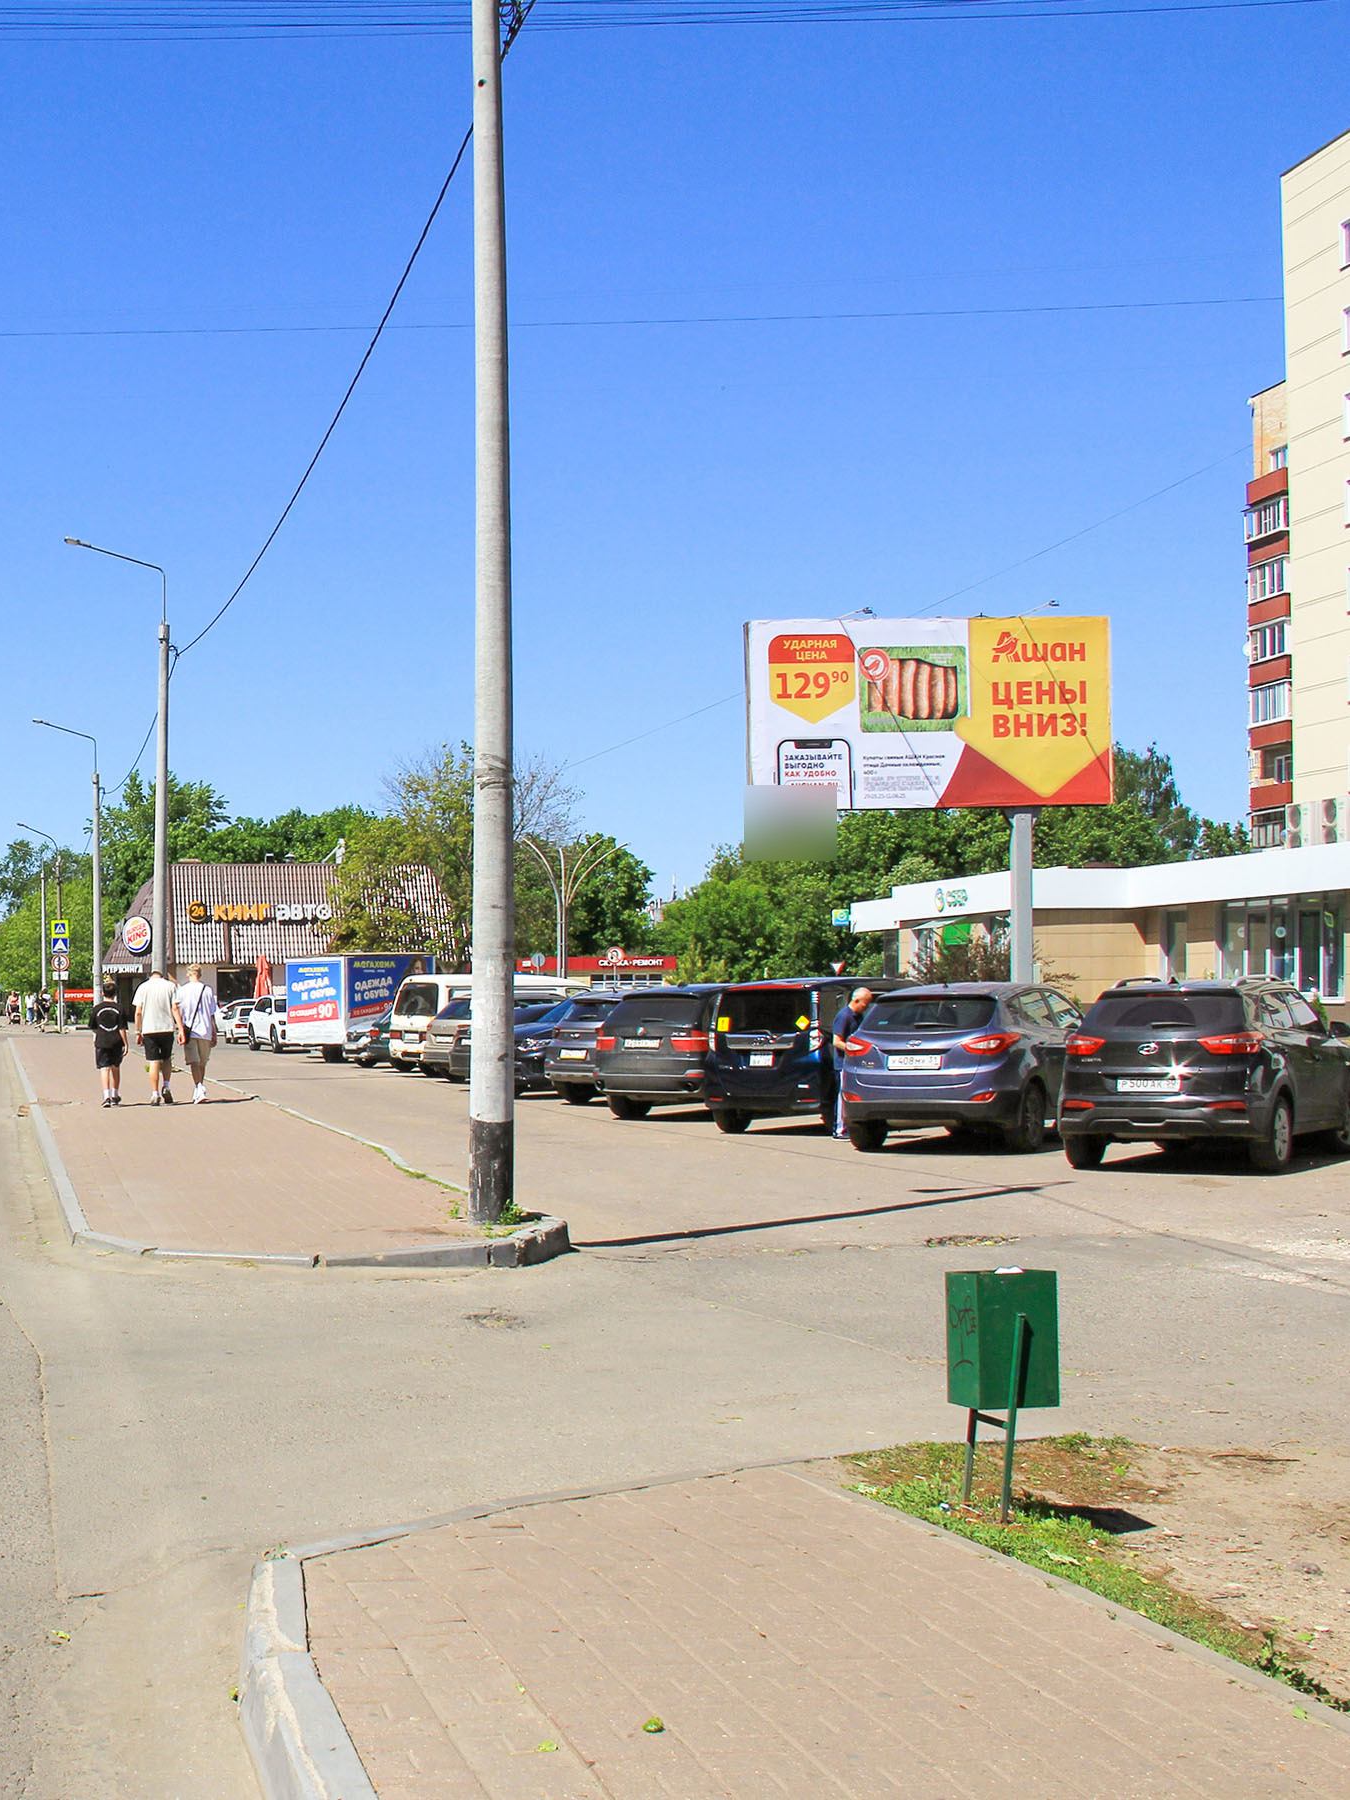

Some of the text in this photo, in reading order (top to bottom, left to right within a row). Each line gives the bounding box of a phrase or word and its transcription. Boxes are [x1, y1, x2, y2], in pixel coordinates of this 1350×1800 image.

[783, 639, 837, 649] УДАРНАЯ
[796, 651, 828, 661] ЦЕНА
[991, 680, 1087, 710] ЦЕНЫ
[992, 713, 1087, 738] ВНИЗ!
[784, 752, 843, 761] ЗАКАЗЫВАЙТЕ
[191, 905, 205, 917] 24
[127, 928, 148, 945] KING
[632, 959, 663, 967] РЕМОНТ
[291, 976, 330, 992] ОДЕЖДА
[354, 976, 393, 991] ОДЕЖДА
[310, 987, 337, 999] ОБУВЬ
[354, 987, 390, 1002] И ОБУВЬ
